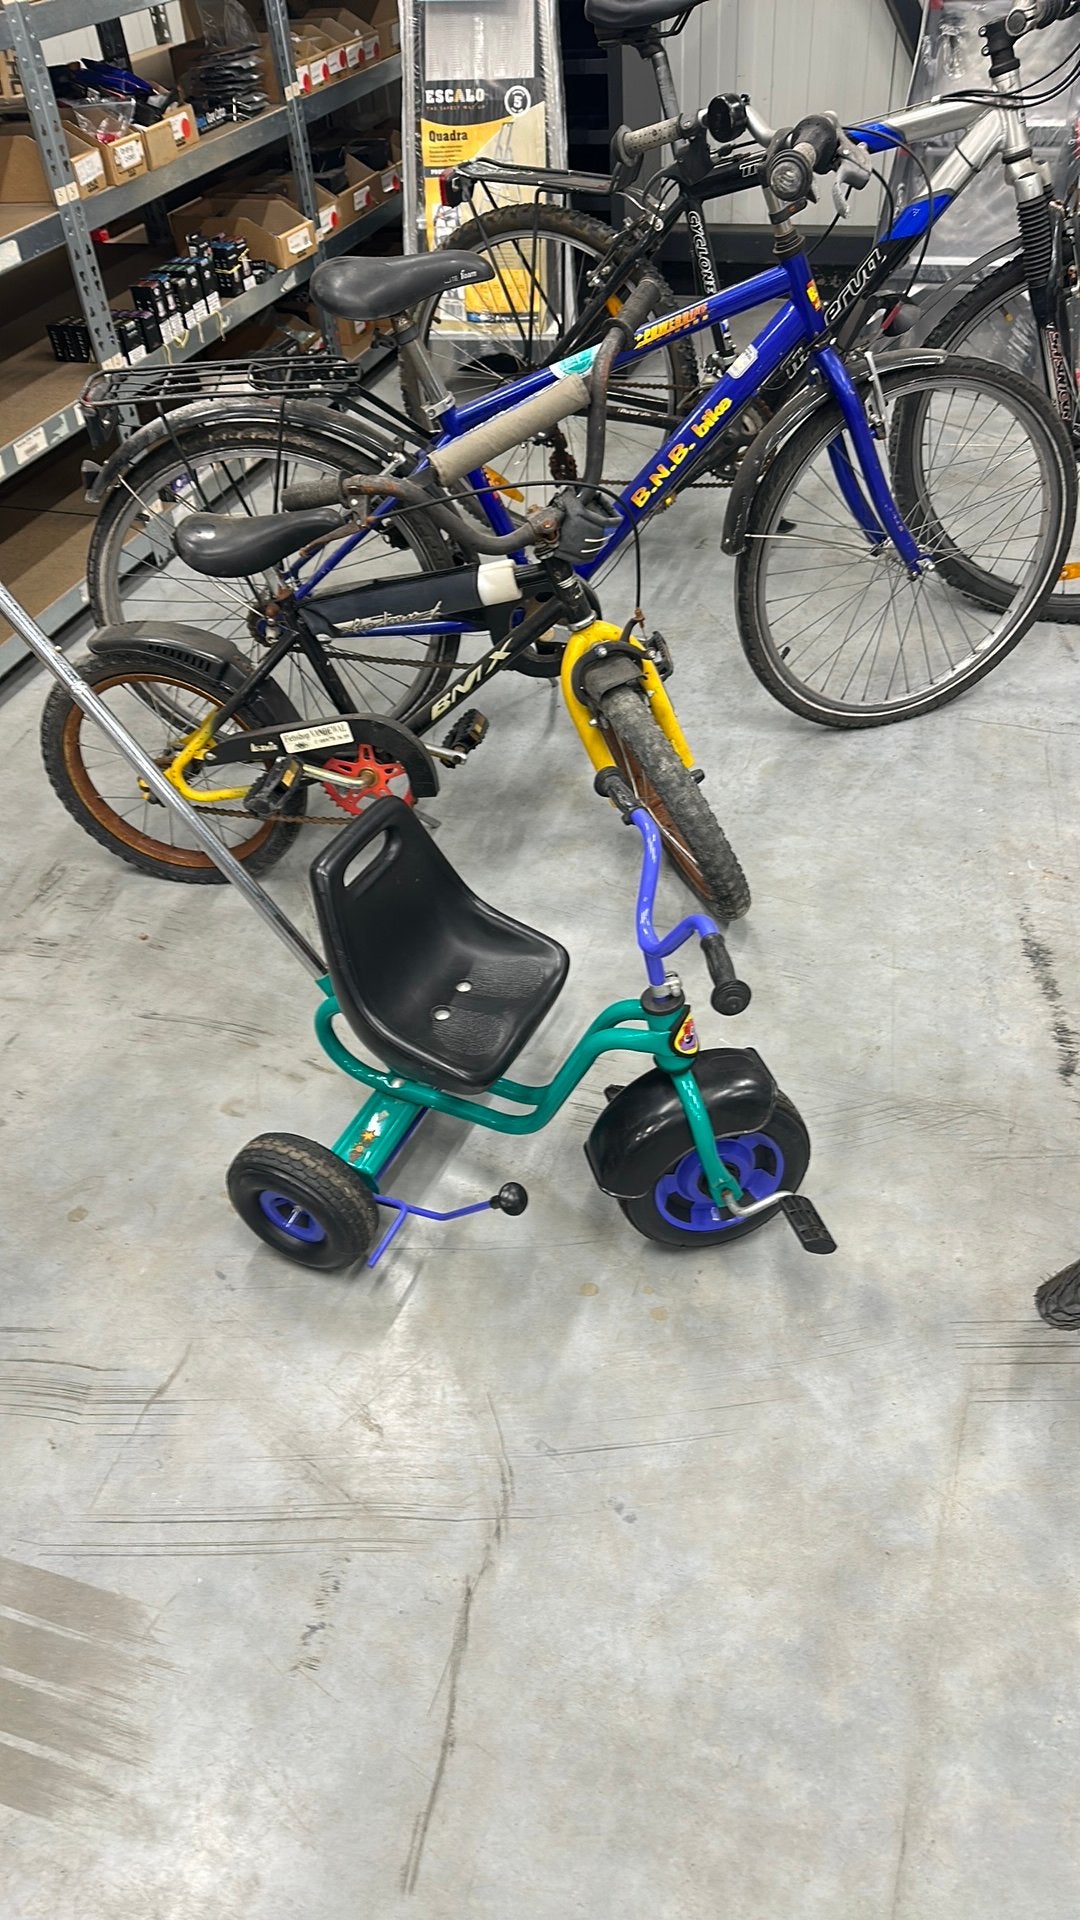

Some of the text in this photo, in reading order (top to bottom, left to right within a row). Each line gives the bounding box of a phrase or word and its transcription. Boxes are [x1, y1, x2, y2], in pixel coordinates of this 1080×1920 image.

[425, 88, 485, 104] ESCALO
[513, 95, 523, 108] 5
[429, 130, 468, 142] Quadra
[630, 443, 696, 508] B.N.B.
[690, 397, 732, 438] bike
[431, 637, 513, 721] BMX
